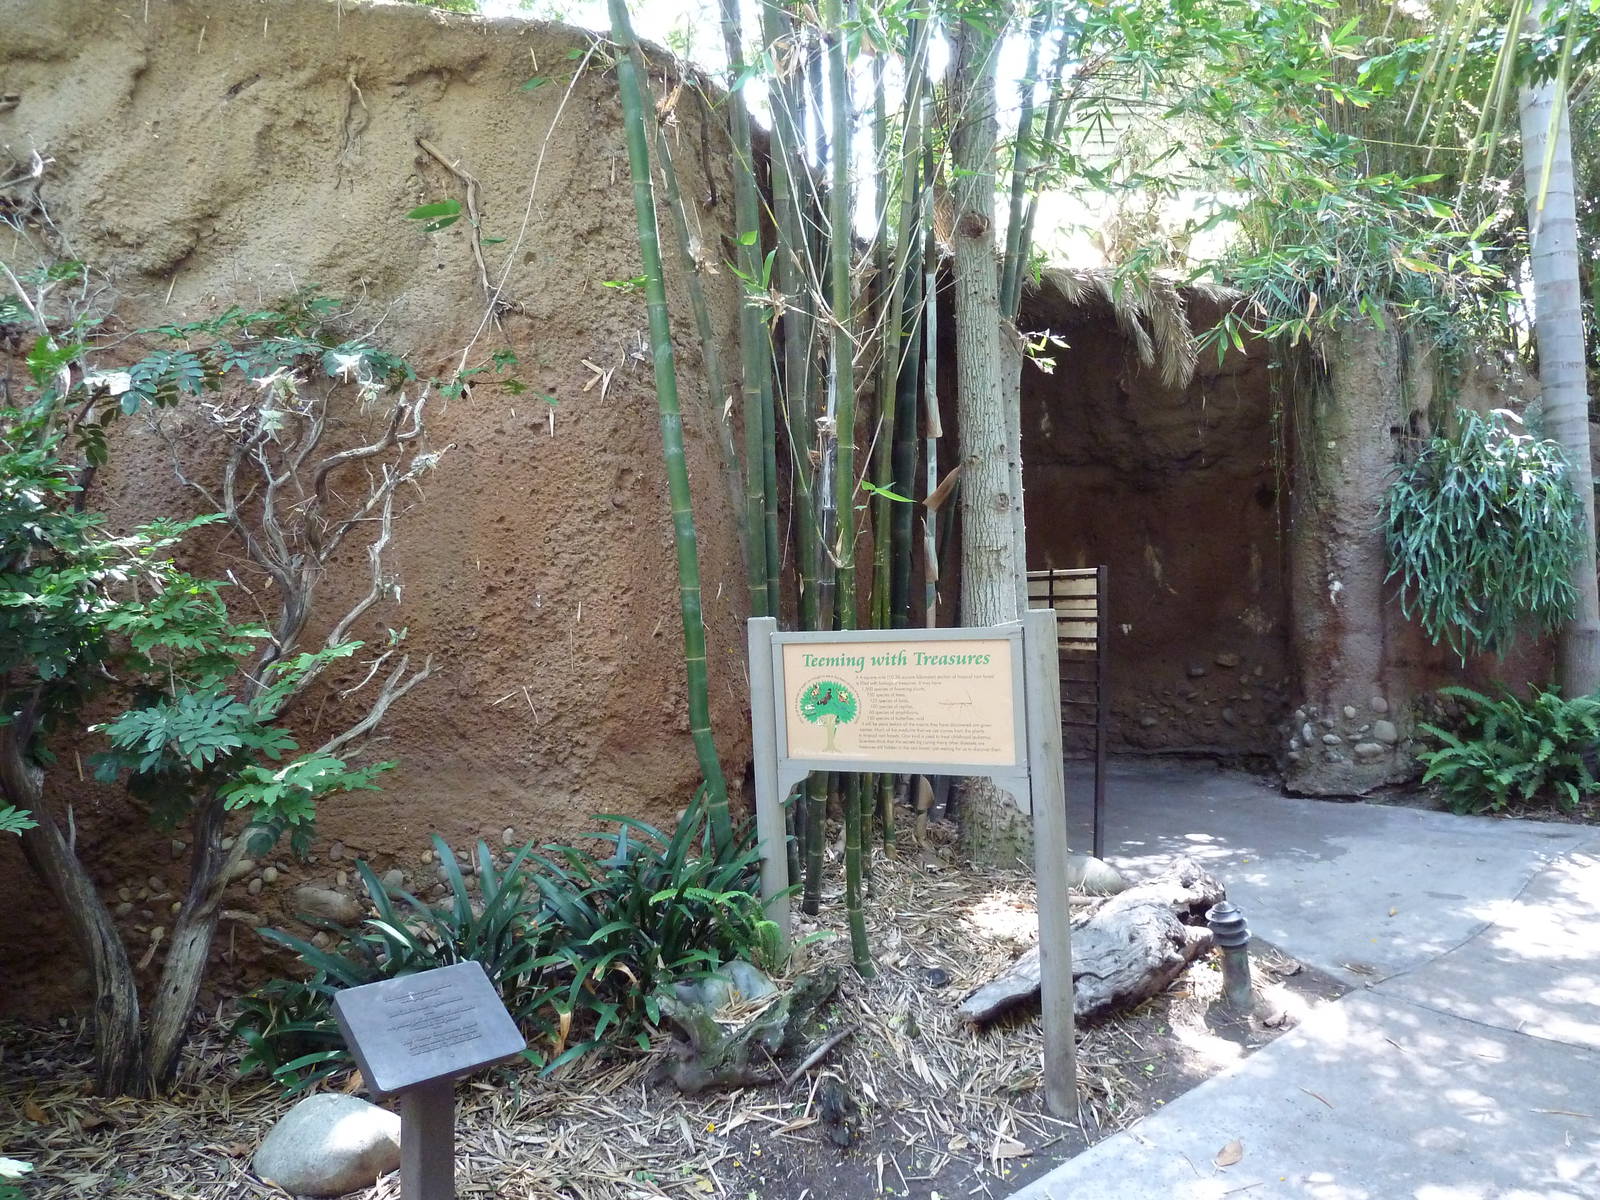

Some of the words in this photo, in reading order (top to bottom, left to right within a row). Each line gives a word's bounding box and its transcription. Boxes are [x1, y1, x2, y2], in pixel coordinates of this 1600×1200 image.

[802, 653, 865, 673] Teeming
[871, 649, 907, 666] with
[913, 651, 991, 666] Treasures
